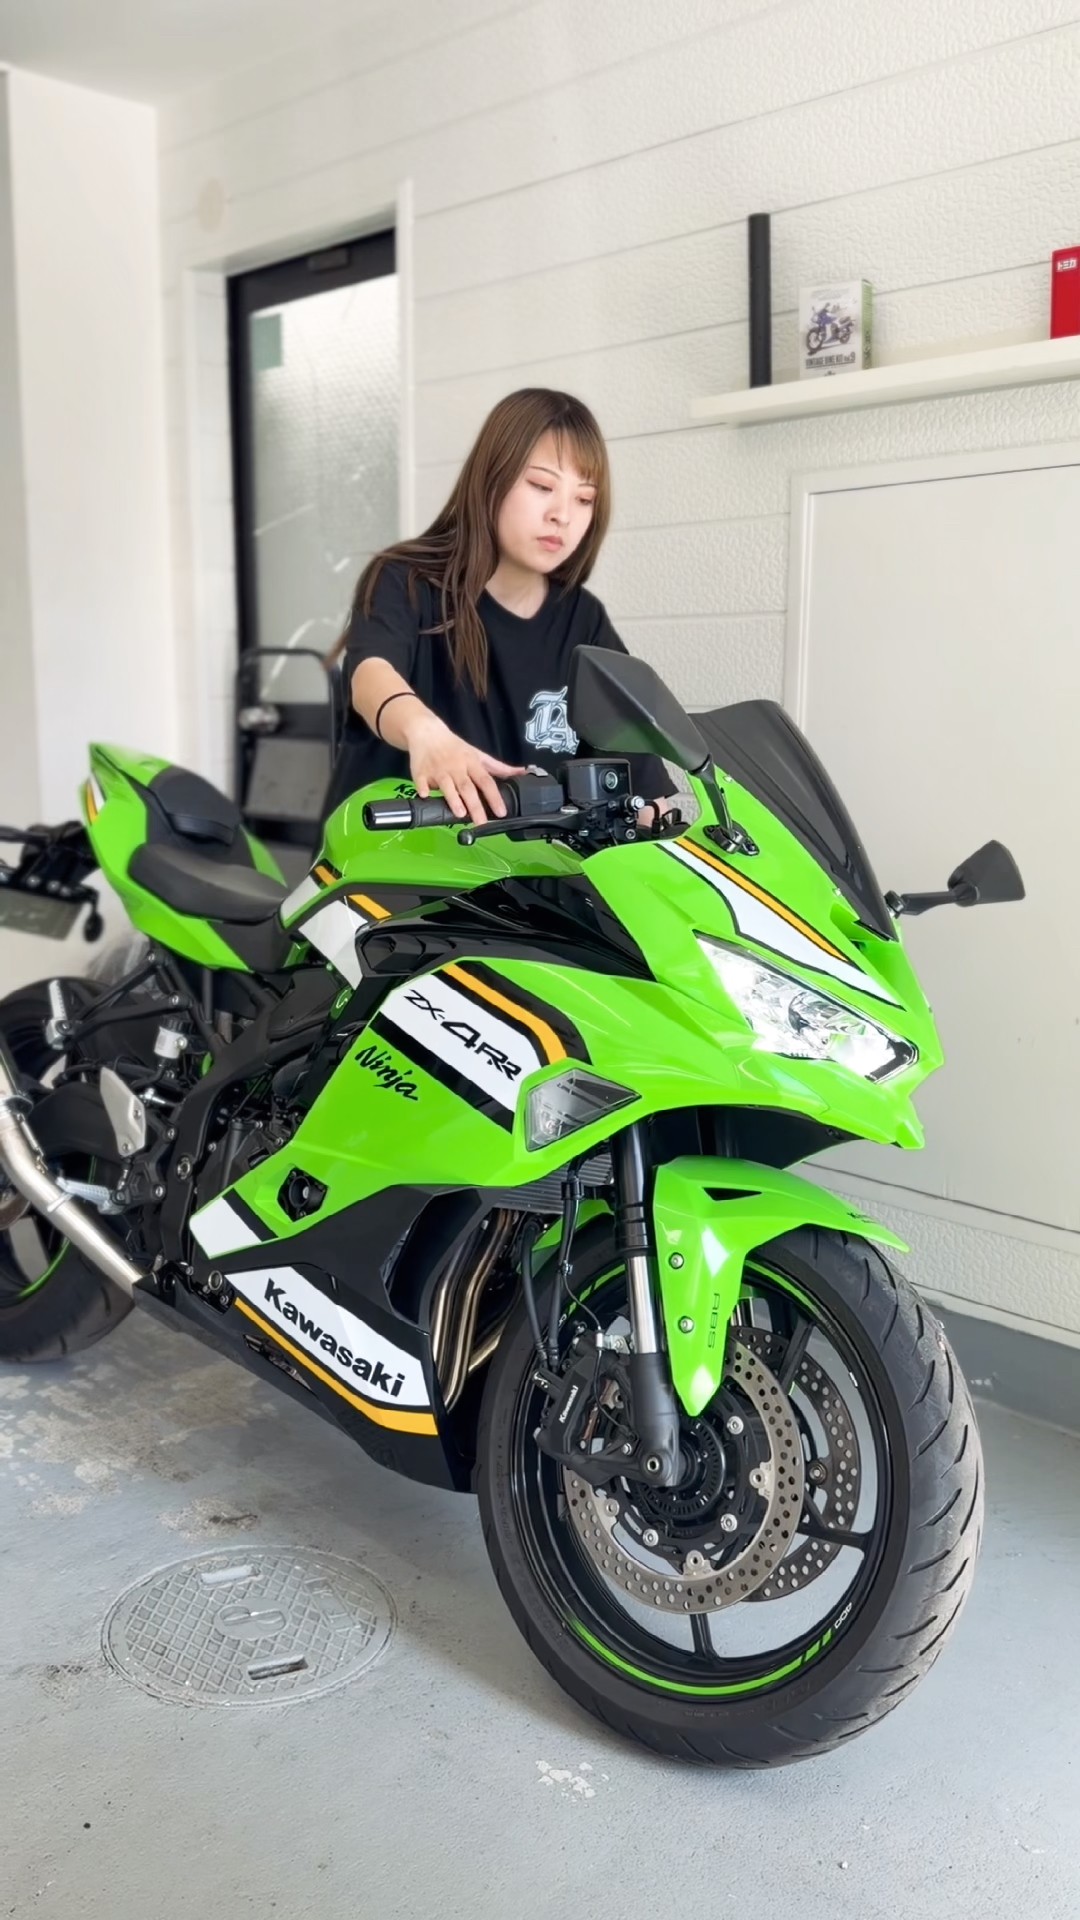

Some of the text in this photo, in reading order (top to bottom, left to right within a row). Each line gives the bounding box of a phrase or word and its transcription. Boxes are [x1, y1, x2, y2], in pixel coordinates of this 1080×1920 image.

[1056, 258, 1077, 272] トミカ
[355, 1045, 419, 1101] Ninja
[264, 1277, 405, 1397] Kawasaki
[707, 1292, 720, 1349] ABS
